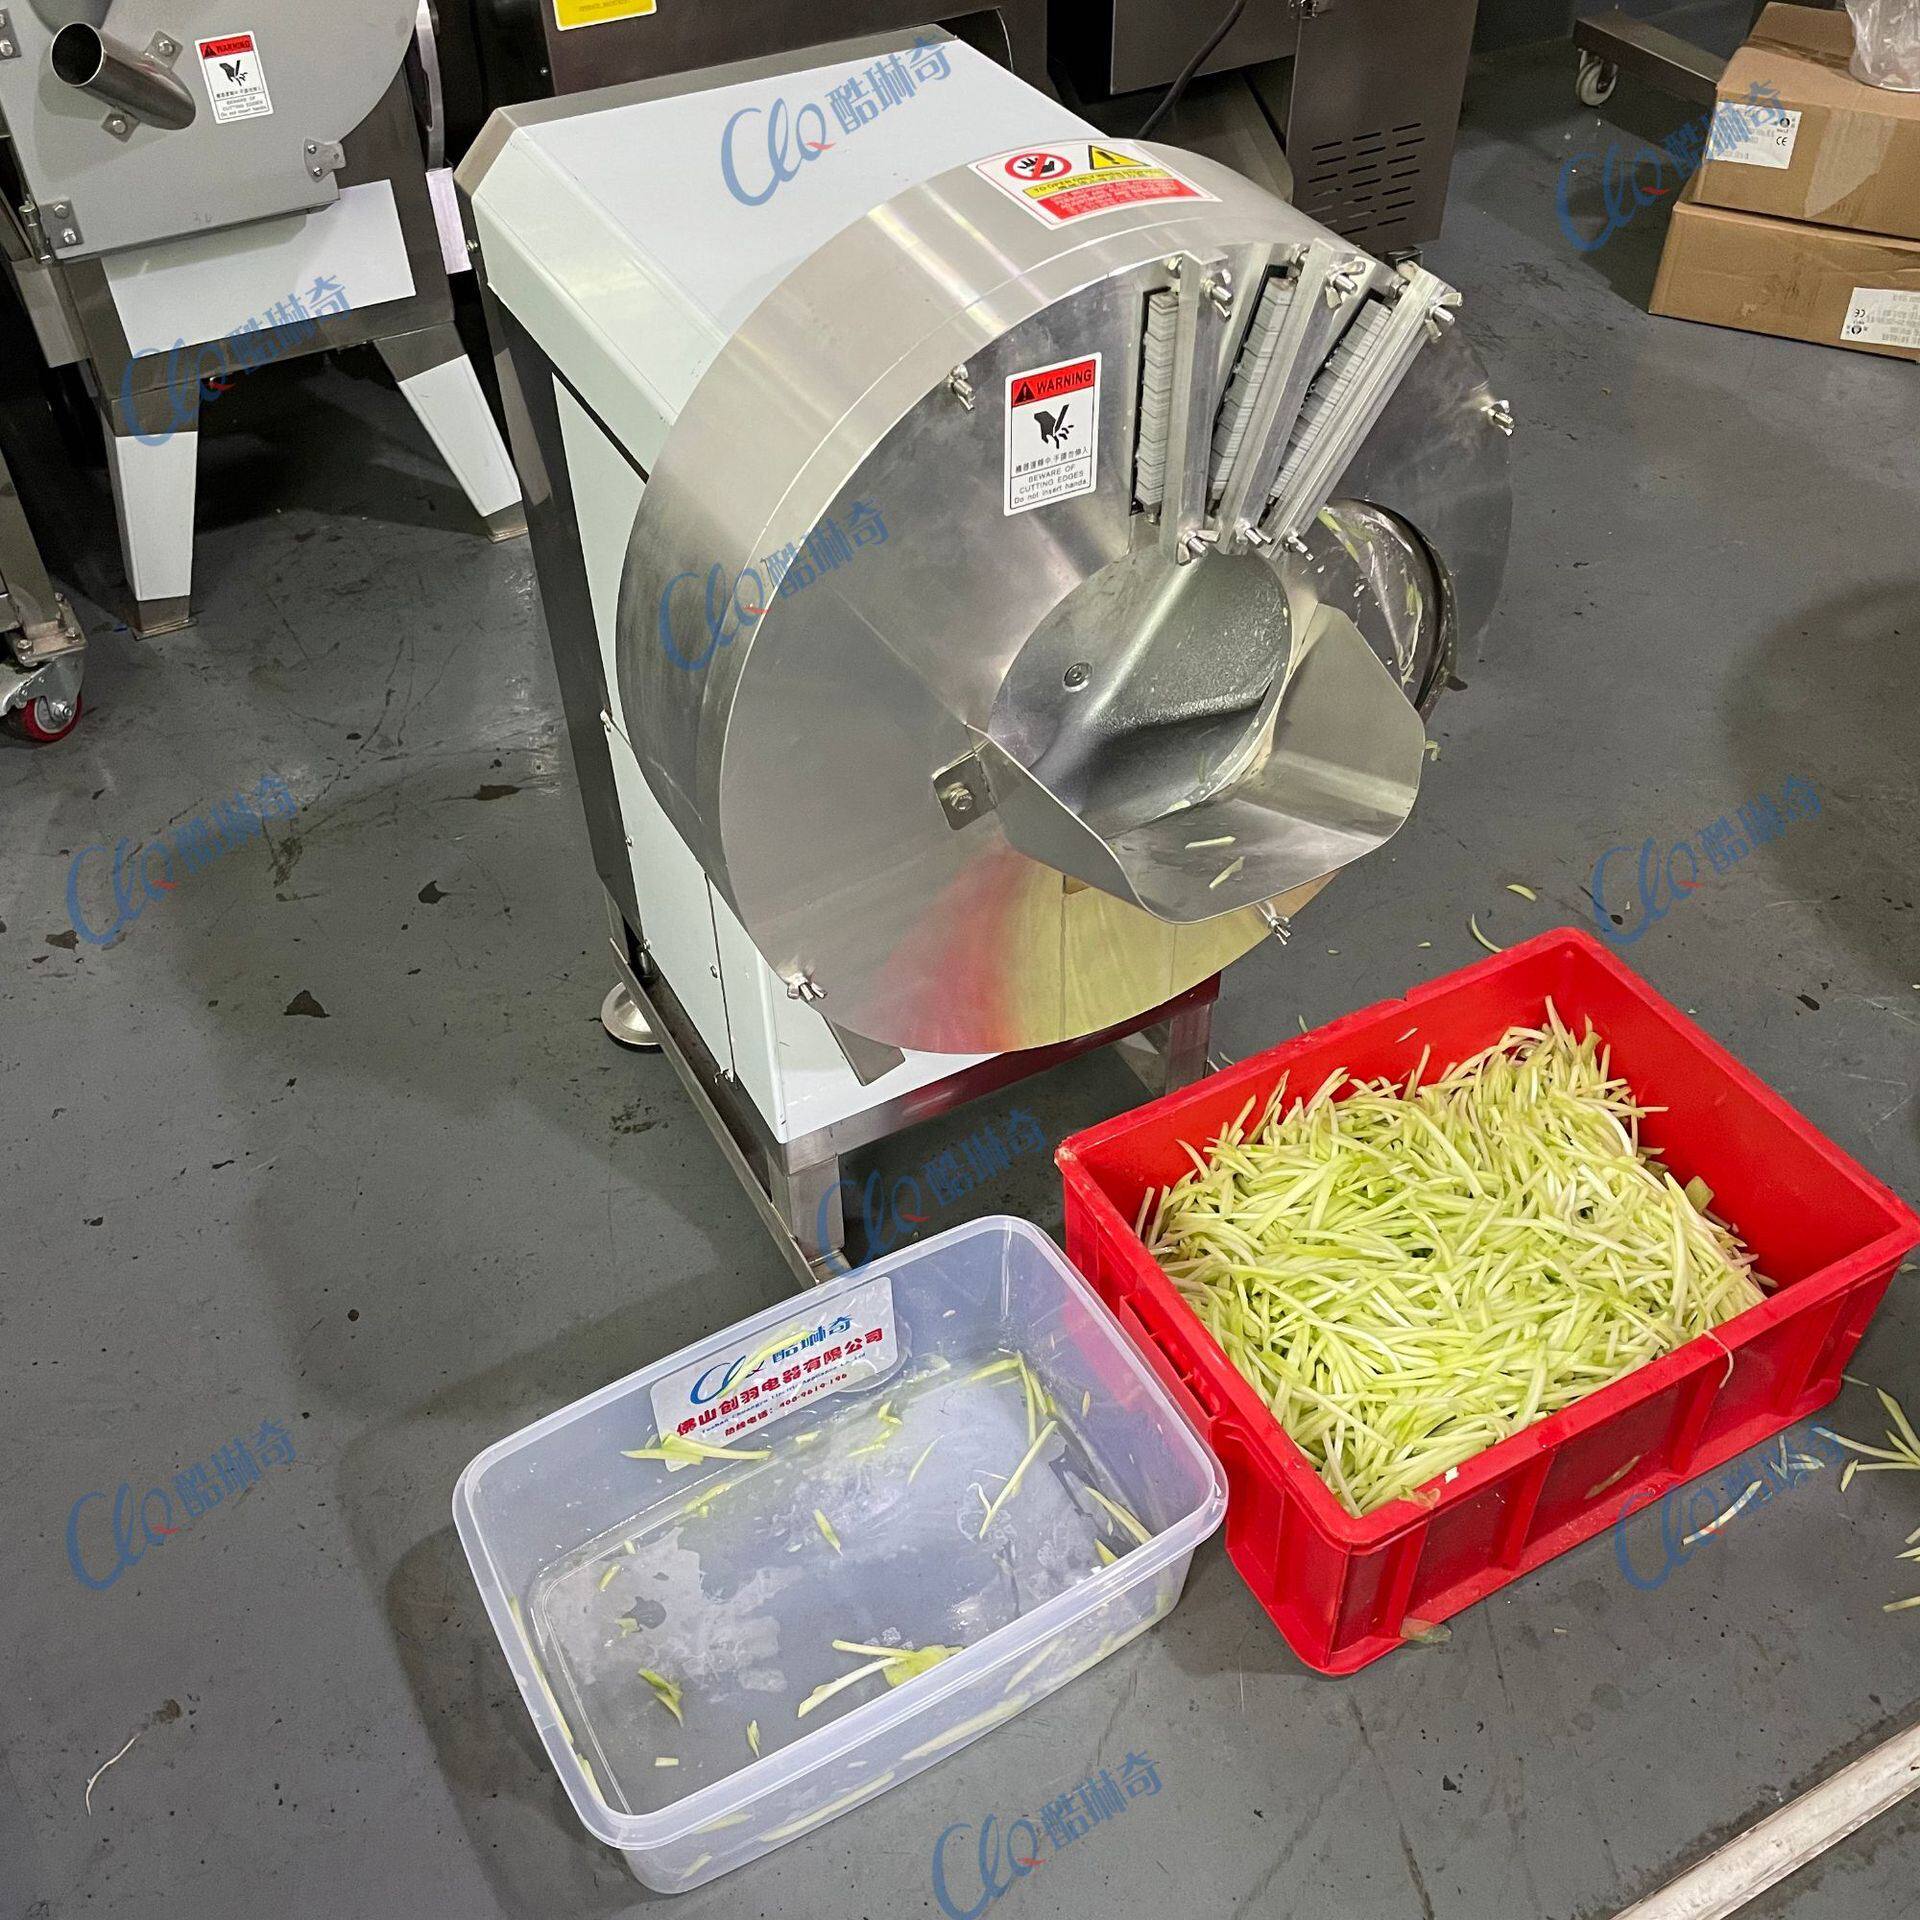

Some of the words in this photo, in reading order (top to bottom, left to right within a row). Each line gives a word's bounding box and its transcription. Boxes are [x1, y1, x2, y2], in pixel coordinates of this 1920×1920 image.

[1037, 369, 1092, 395] WARNING
[1020, 480, 1054, 494] CUTTING
[1058, 471, 1084, 484] EDGES
[1028, 468, 1062, 484] BEWARE
[1064, 464, 1075, 475] OF
[1014, 493, 1025, 504] Do
[1028, 490, 1039, 501] not
[1042, 484, 1062, 498] insert
[676, 1328, 883, 1436] 佛山创羽电器有限公司
